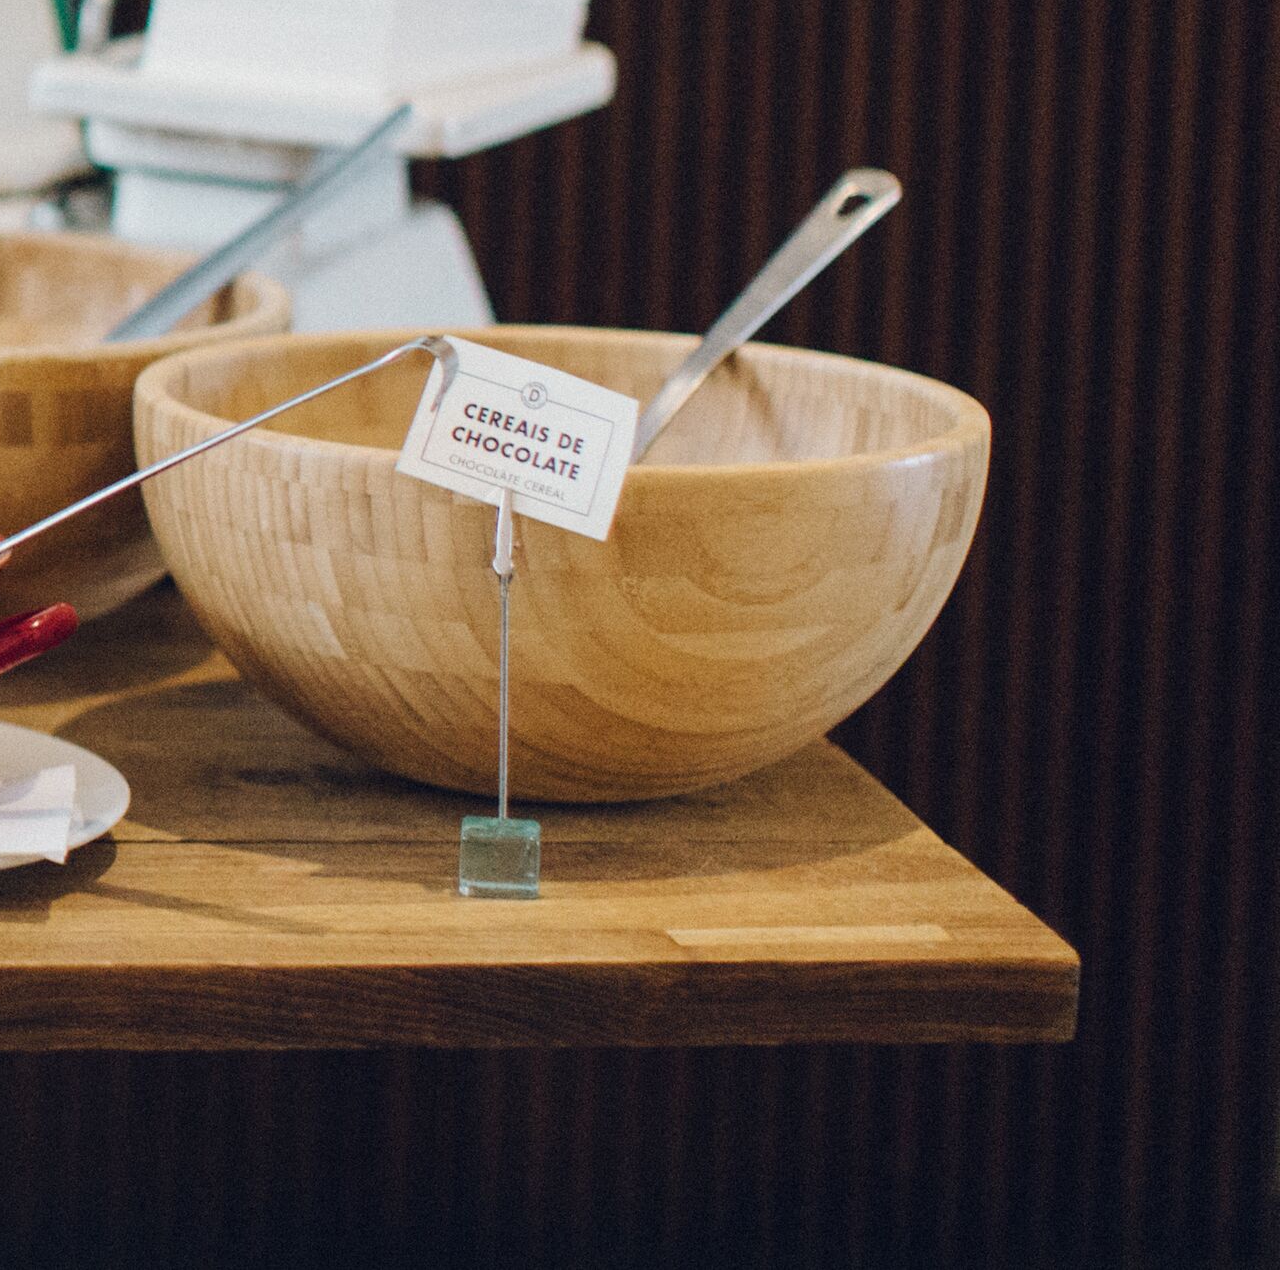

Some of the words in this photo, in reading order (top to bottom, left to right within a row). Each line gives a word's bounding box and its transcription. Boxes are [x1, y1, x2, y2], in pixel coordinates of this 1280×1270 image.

[529, 388, 540, 403] D
[451, 426, 580, 481] CHOCOLATE
[464, 403, 550, 443] CEREAIS
[557, 432, 584, 455] DE
[449, 453, 520, 486] CHOCOLATE
[524, 479, 566, 501] CEREAL
